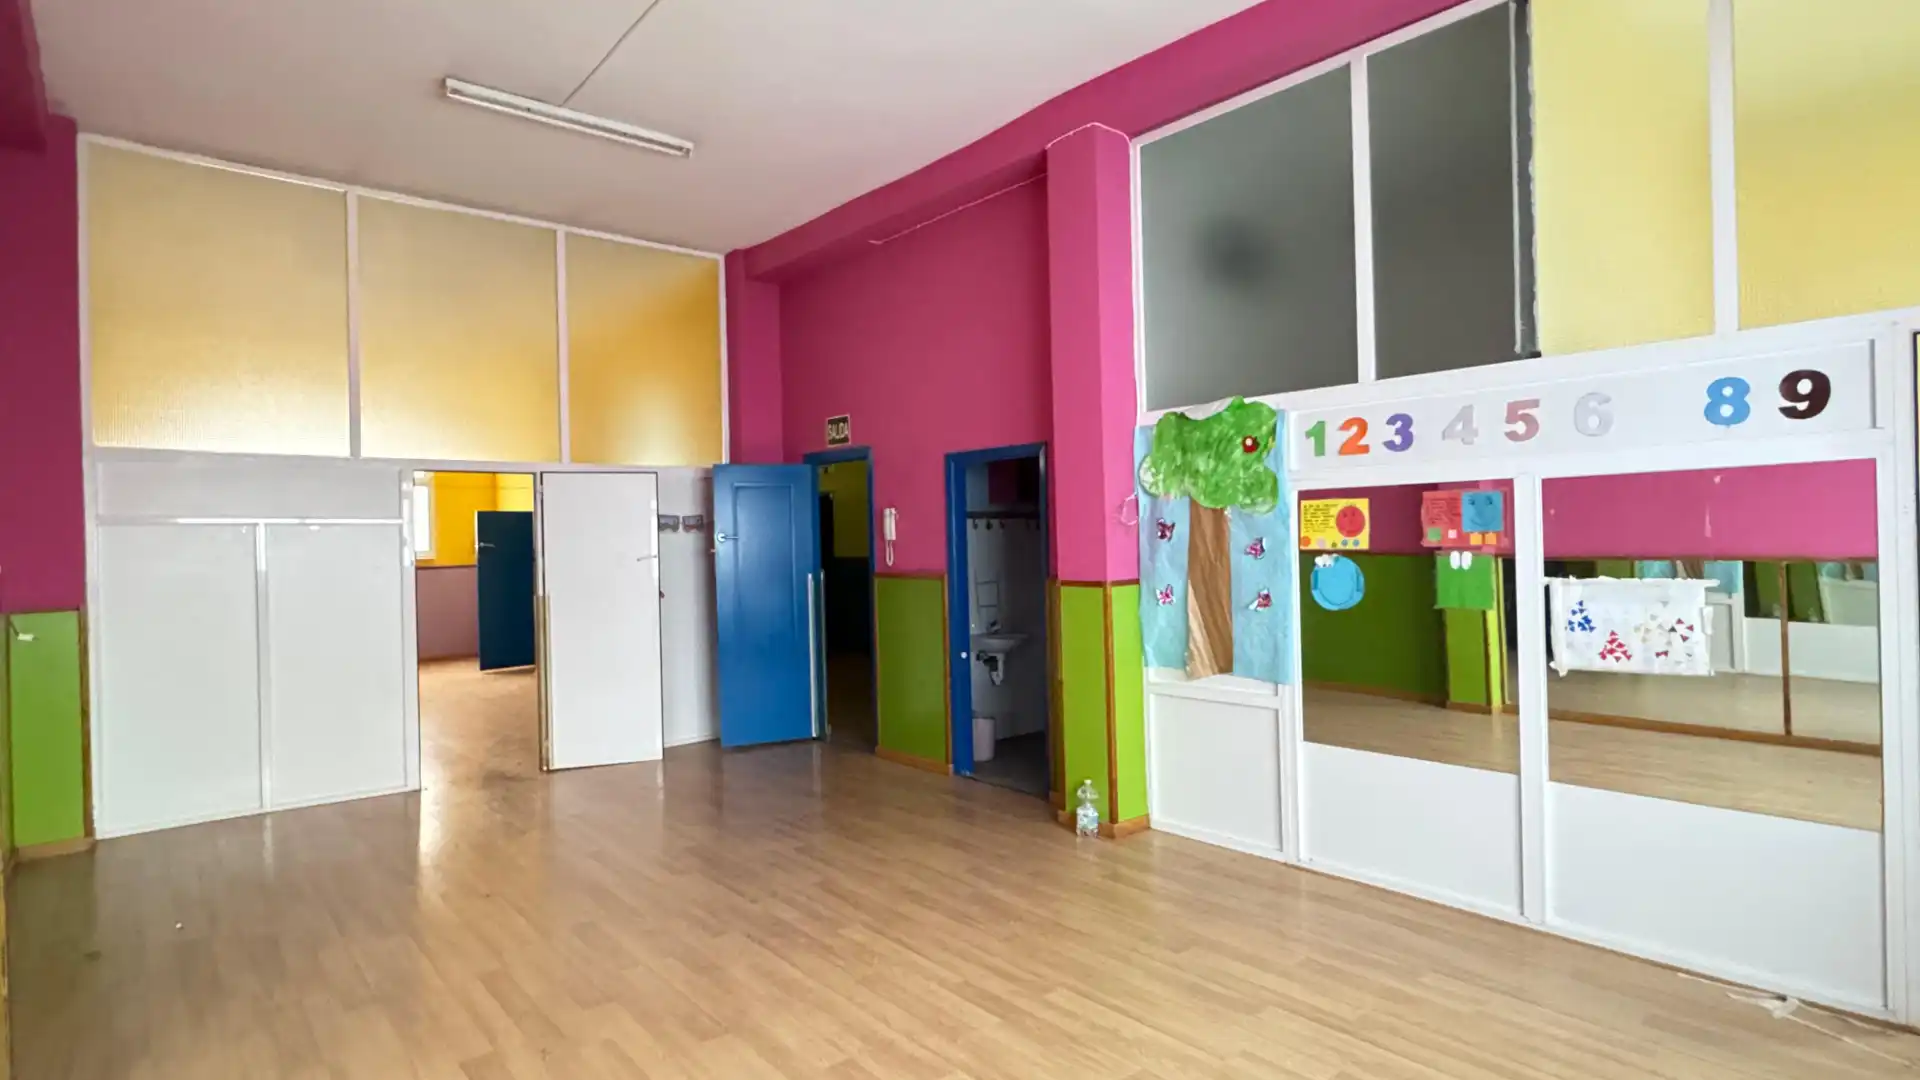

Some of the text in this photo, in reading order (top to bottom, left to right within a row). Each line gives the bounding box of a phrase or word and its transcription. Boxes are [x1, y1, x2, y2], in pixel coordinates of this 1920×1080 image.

[828, 421, 849, 440] SALIDA
[1305, 369, 1831, 456] 1 2 3 4 5 6 8 9
